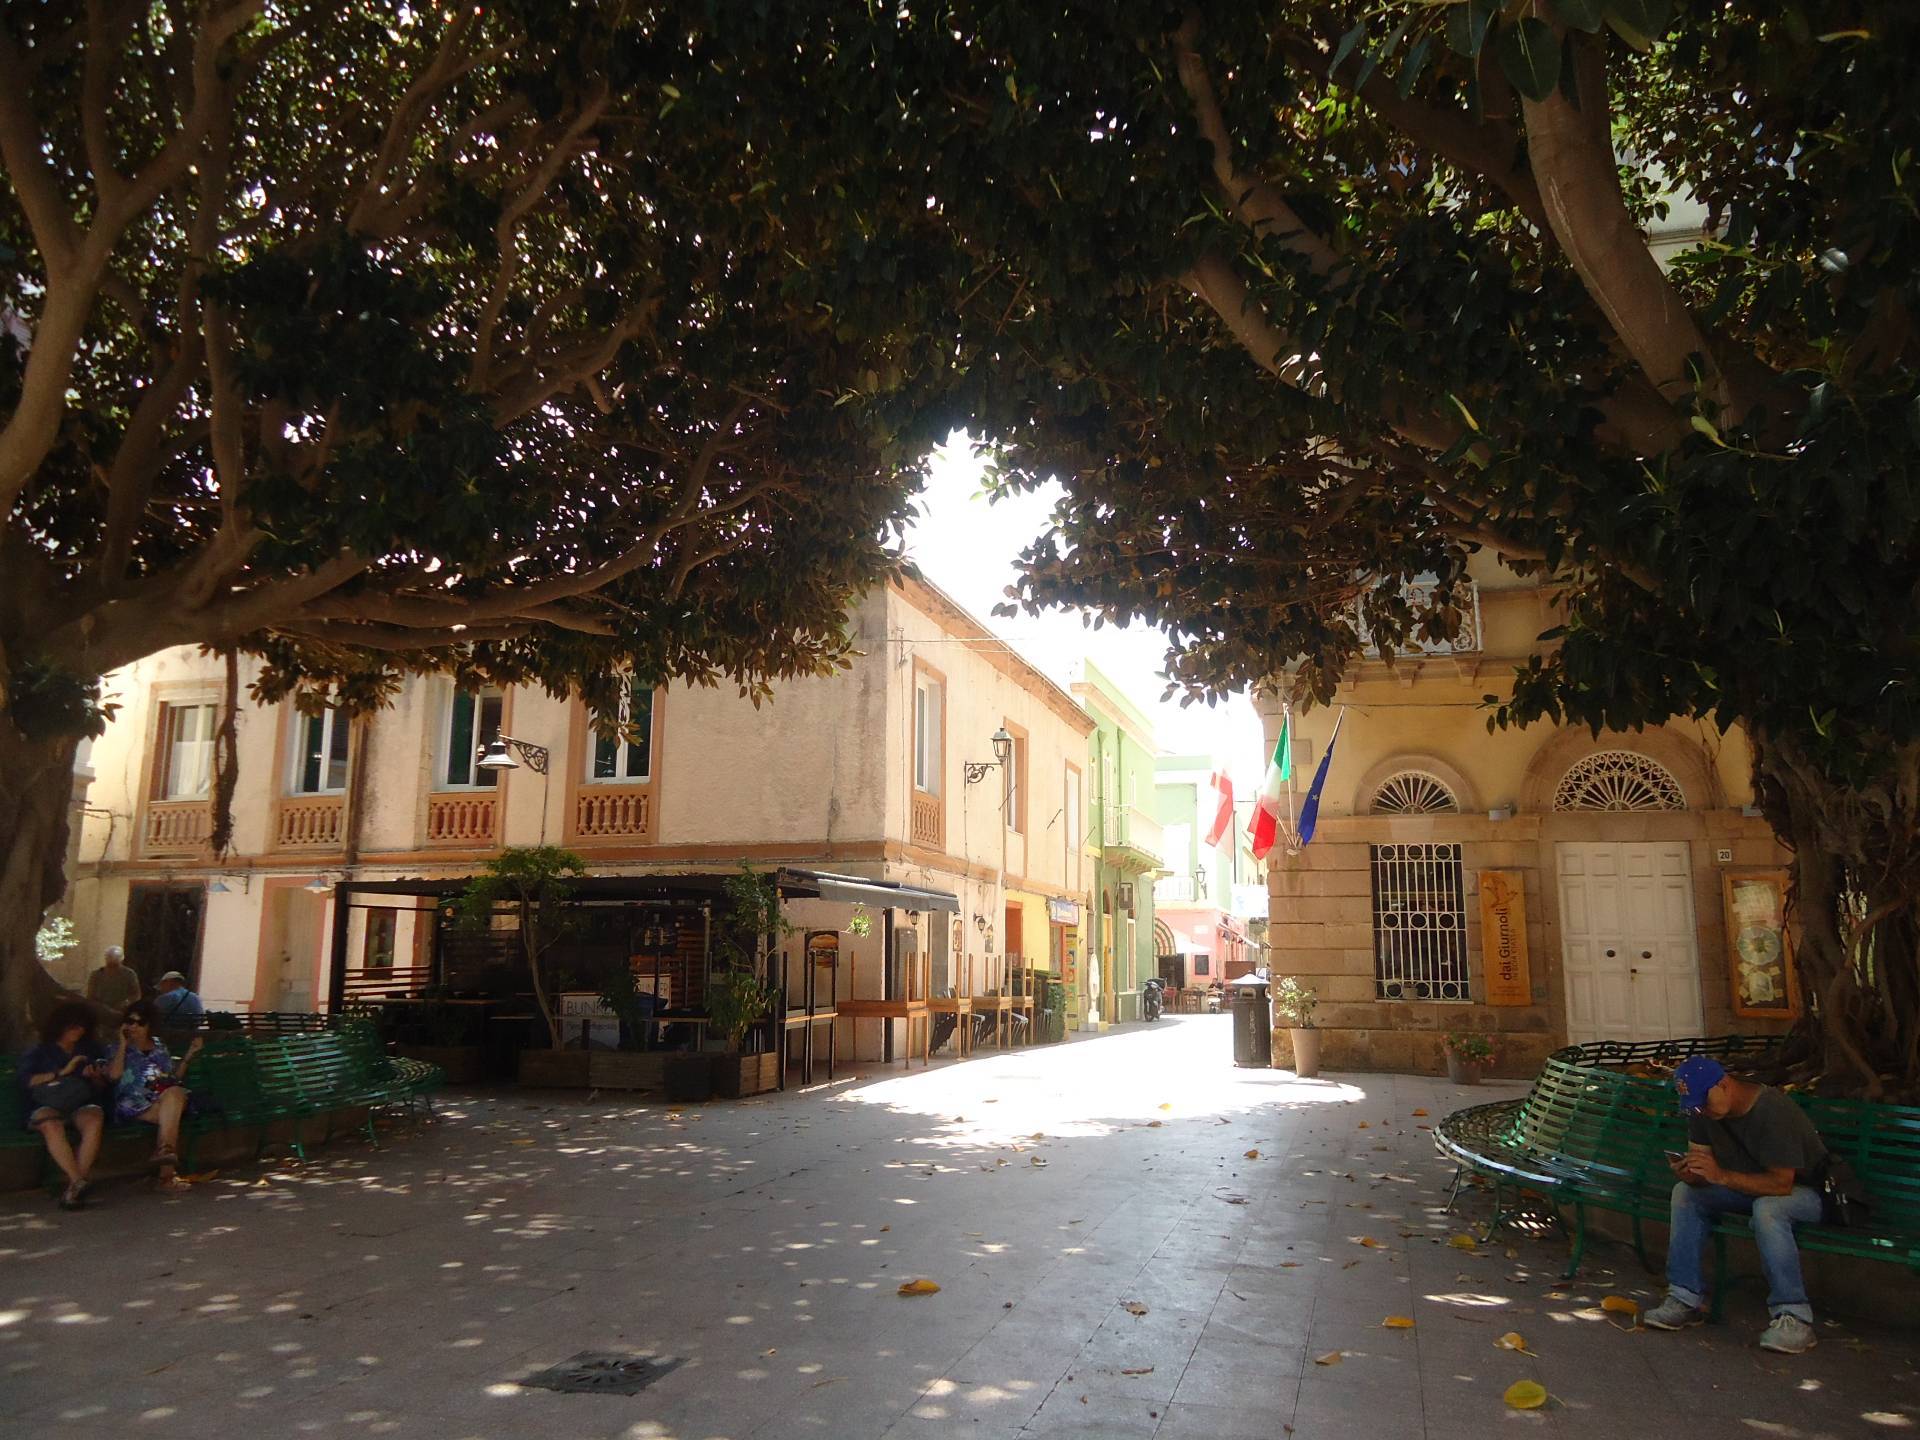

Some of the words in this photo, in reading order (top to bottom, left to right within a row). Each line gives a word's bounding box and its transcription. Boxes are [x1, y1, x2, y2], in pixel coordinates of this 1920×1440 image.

[1719, 851, 1730, 860] 20
[1121, 884, 1131, 902] T
[1495, 907, 1511, 959] Giurnoli
[1499, 961, 1512, 980] dai
